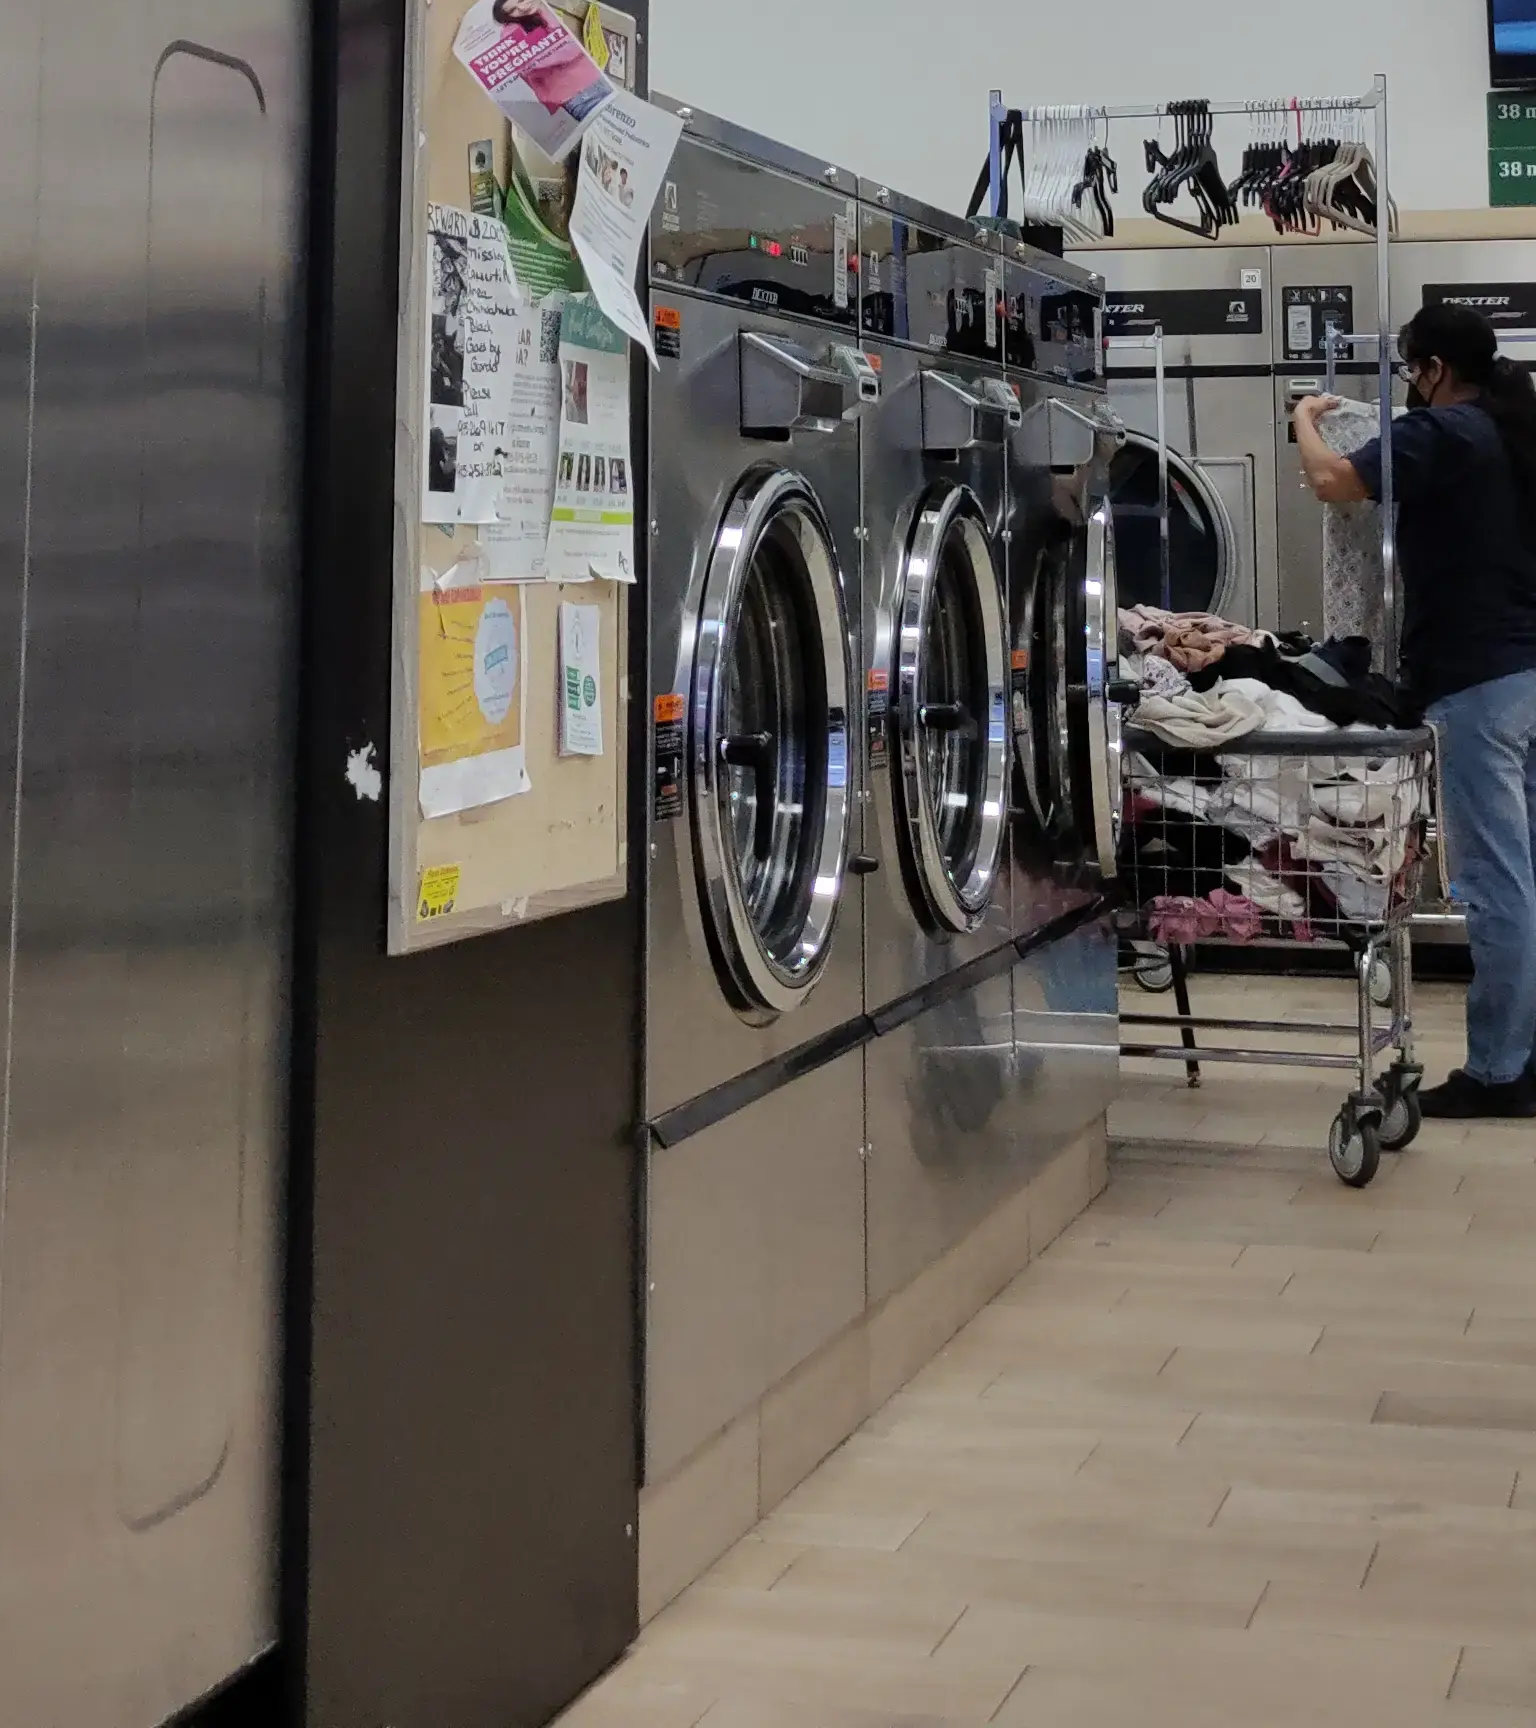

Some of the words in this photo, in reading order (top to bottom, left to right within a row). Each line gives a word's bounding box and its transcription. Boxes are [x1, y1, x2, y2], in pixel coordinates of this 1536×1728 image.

[480, 40, 530, 76] YOU'RE
[486, 27, 566, 86] PREGNANT?
[1497, 103, 1521, 119] 38
[1498, 161, 1523, 178] 38
[427, 202, 468, 238] REWARD
[1245, 274, 1257, 284] 20
[751, 287, 778, 305] DEXTER
